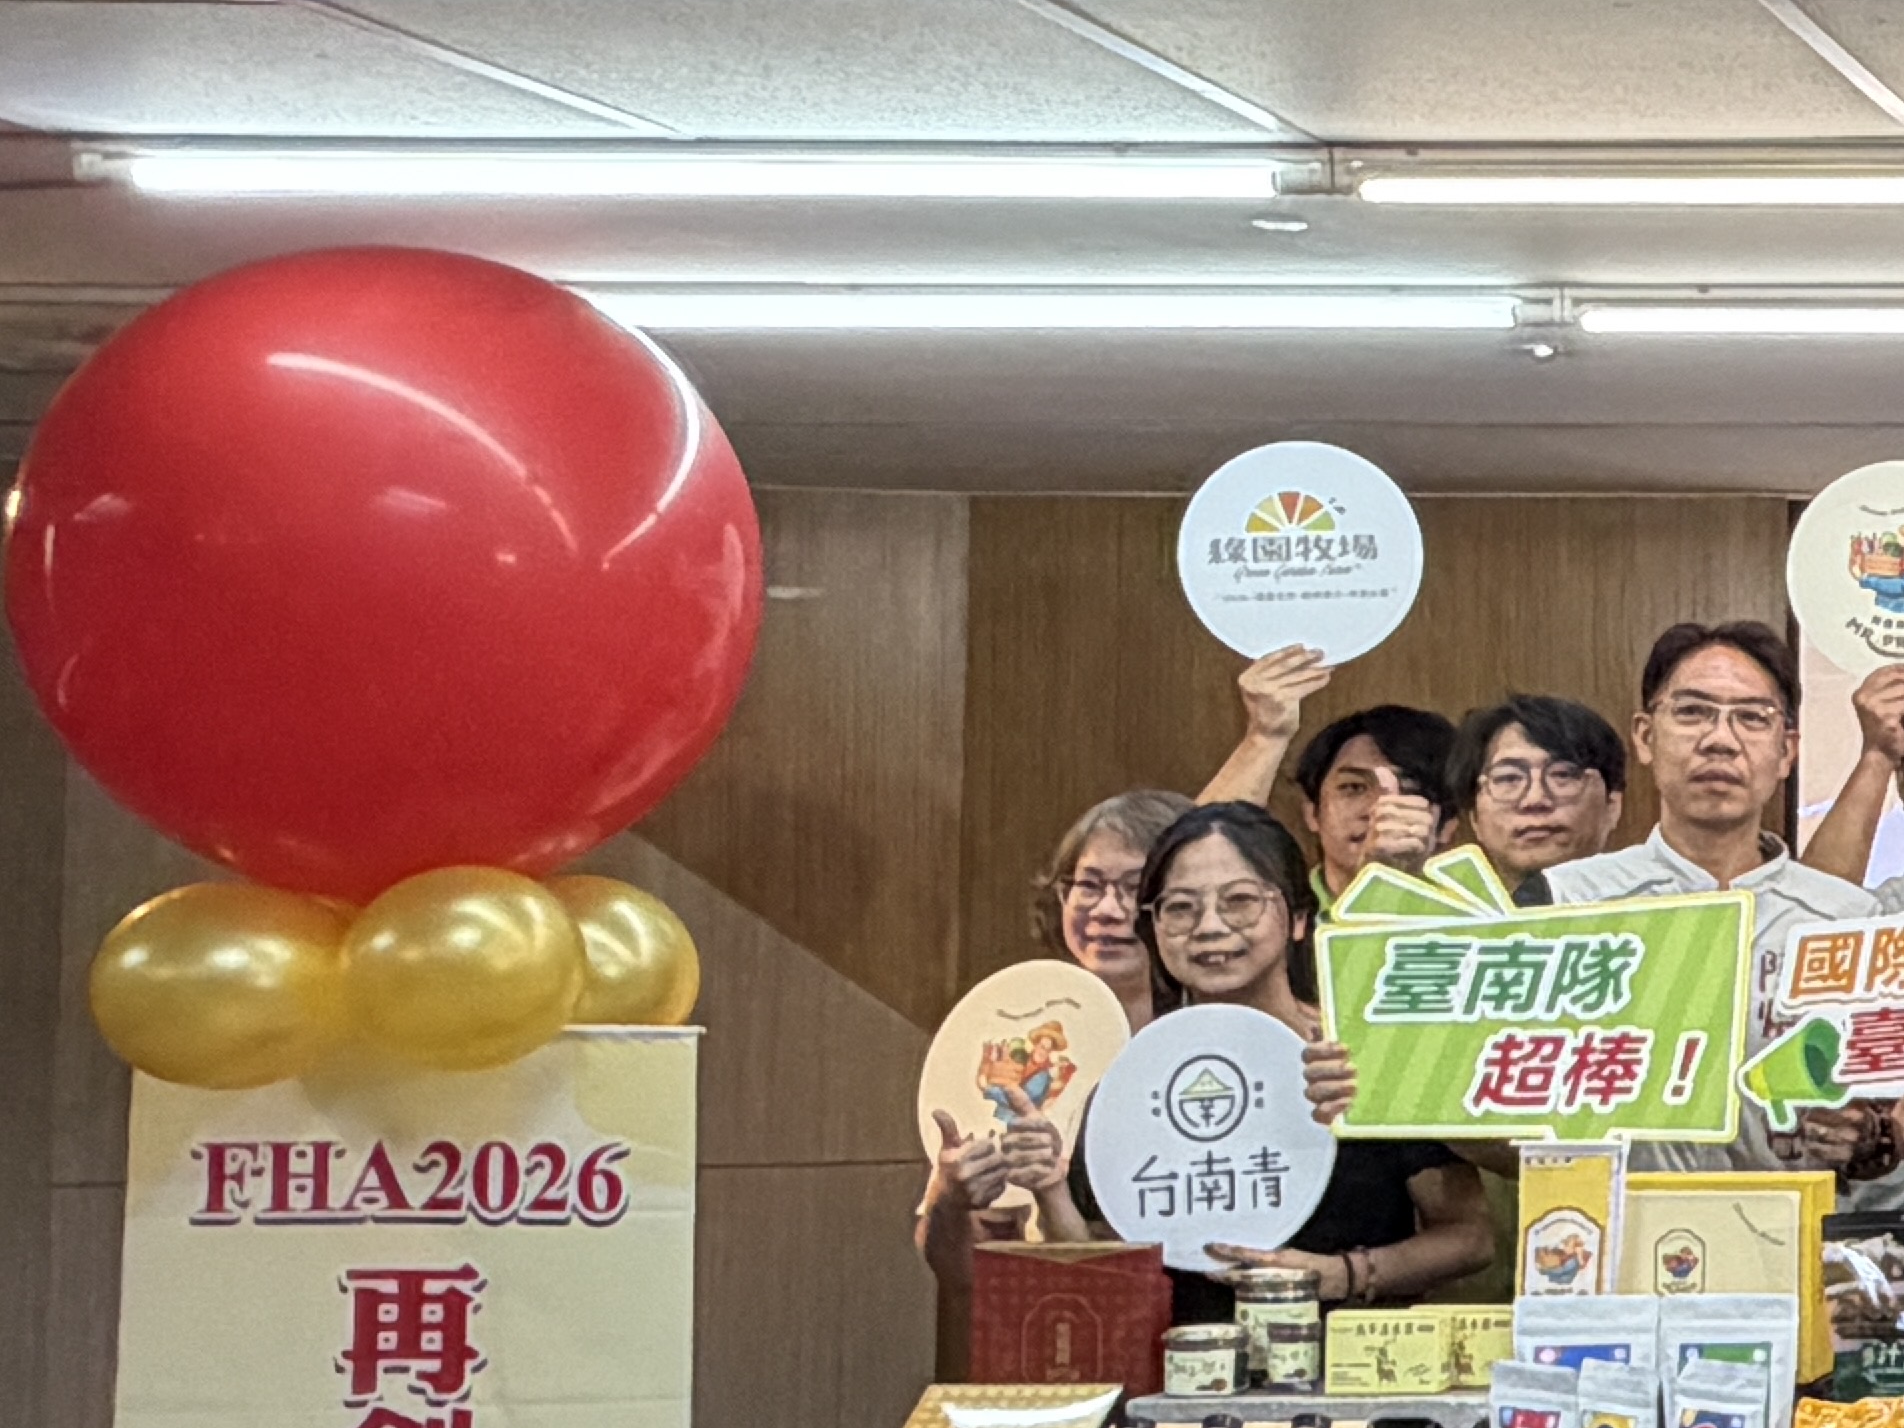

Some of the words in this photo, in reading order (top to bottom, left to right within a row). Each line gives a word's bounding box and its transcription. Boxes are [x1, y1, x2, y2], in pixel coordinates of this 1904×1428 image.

[1372, 938, 1638, 1016] 臺南隊
[195, 1139, 628, 1220] FHA2026
[1131, 1145, 1291, 1219] 台南青
